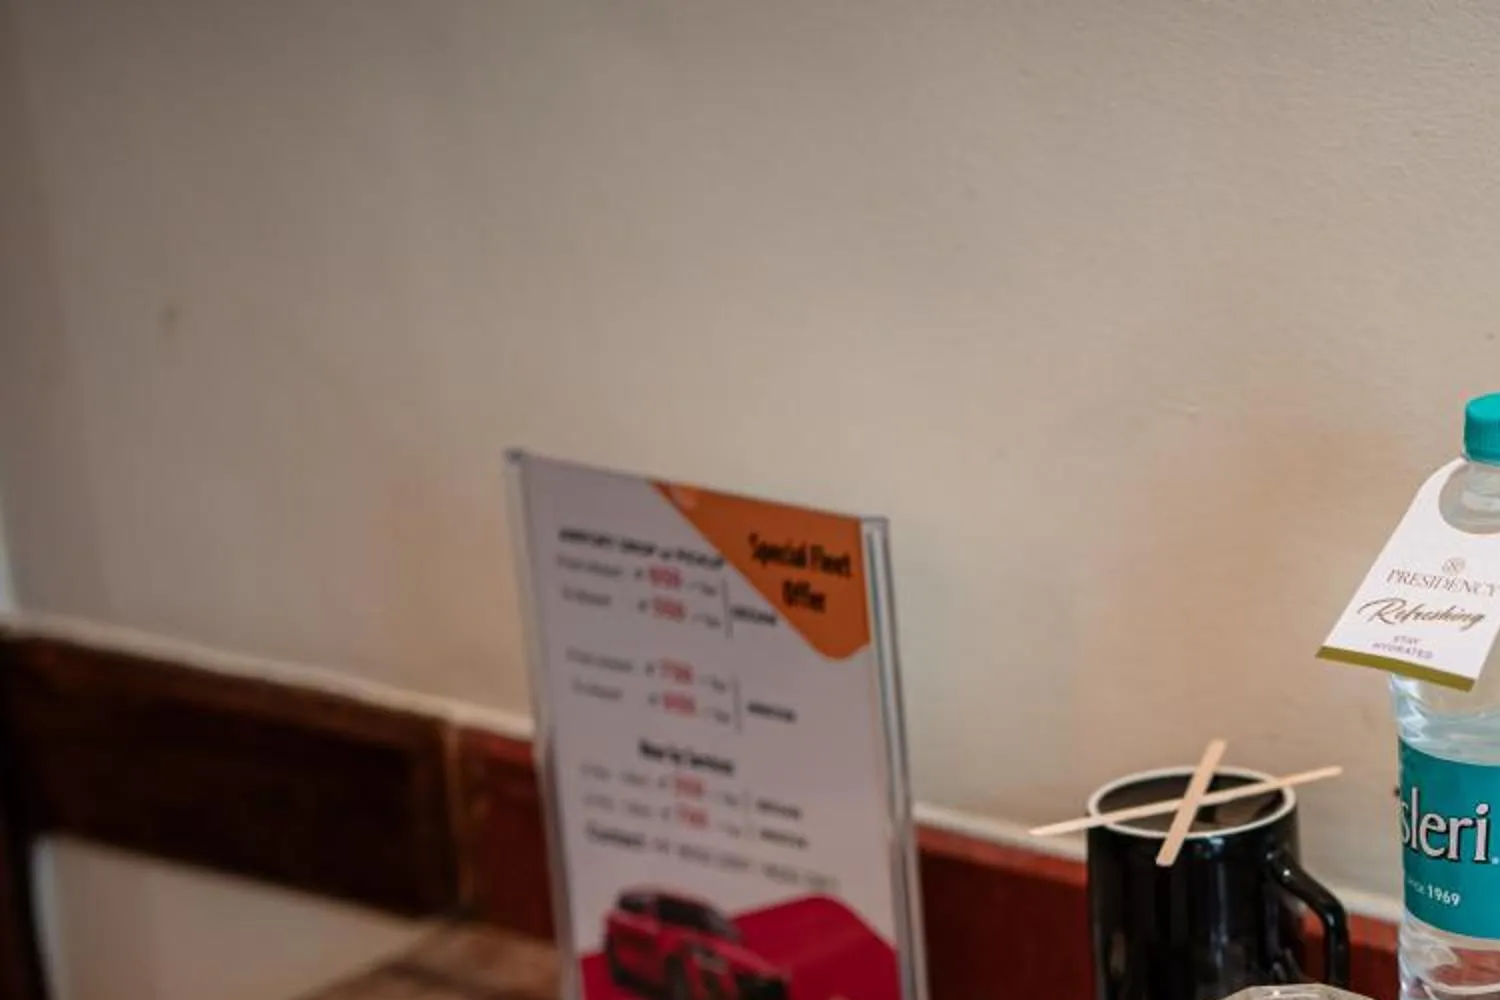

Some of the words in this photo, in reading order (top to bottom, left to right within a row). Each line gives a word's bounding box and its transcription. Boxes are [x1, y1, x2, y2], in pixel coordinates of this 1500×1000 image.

[747, 532, 806, 569] Special
[782, 579, 826, 614] Offer
[1387, 568, 1500, 597] PRESIDENCY
[1357, 598, 1485, 632] Refreshing
[1427, 884, 1461, 907] 1969
